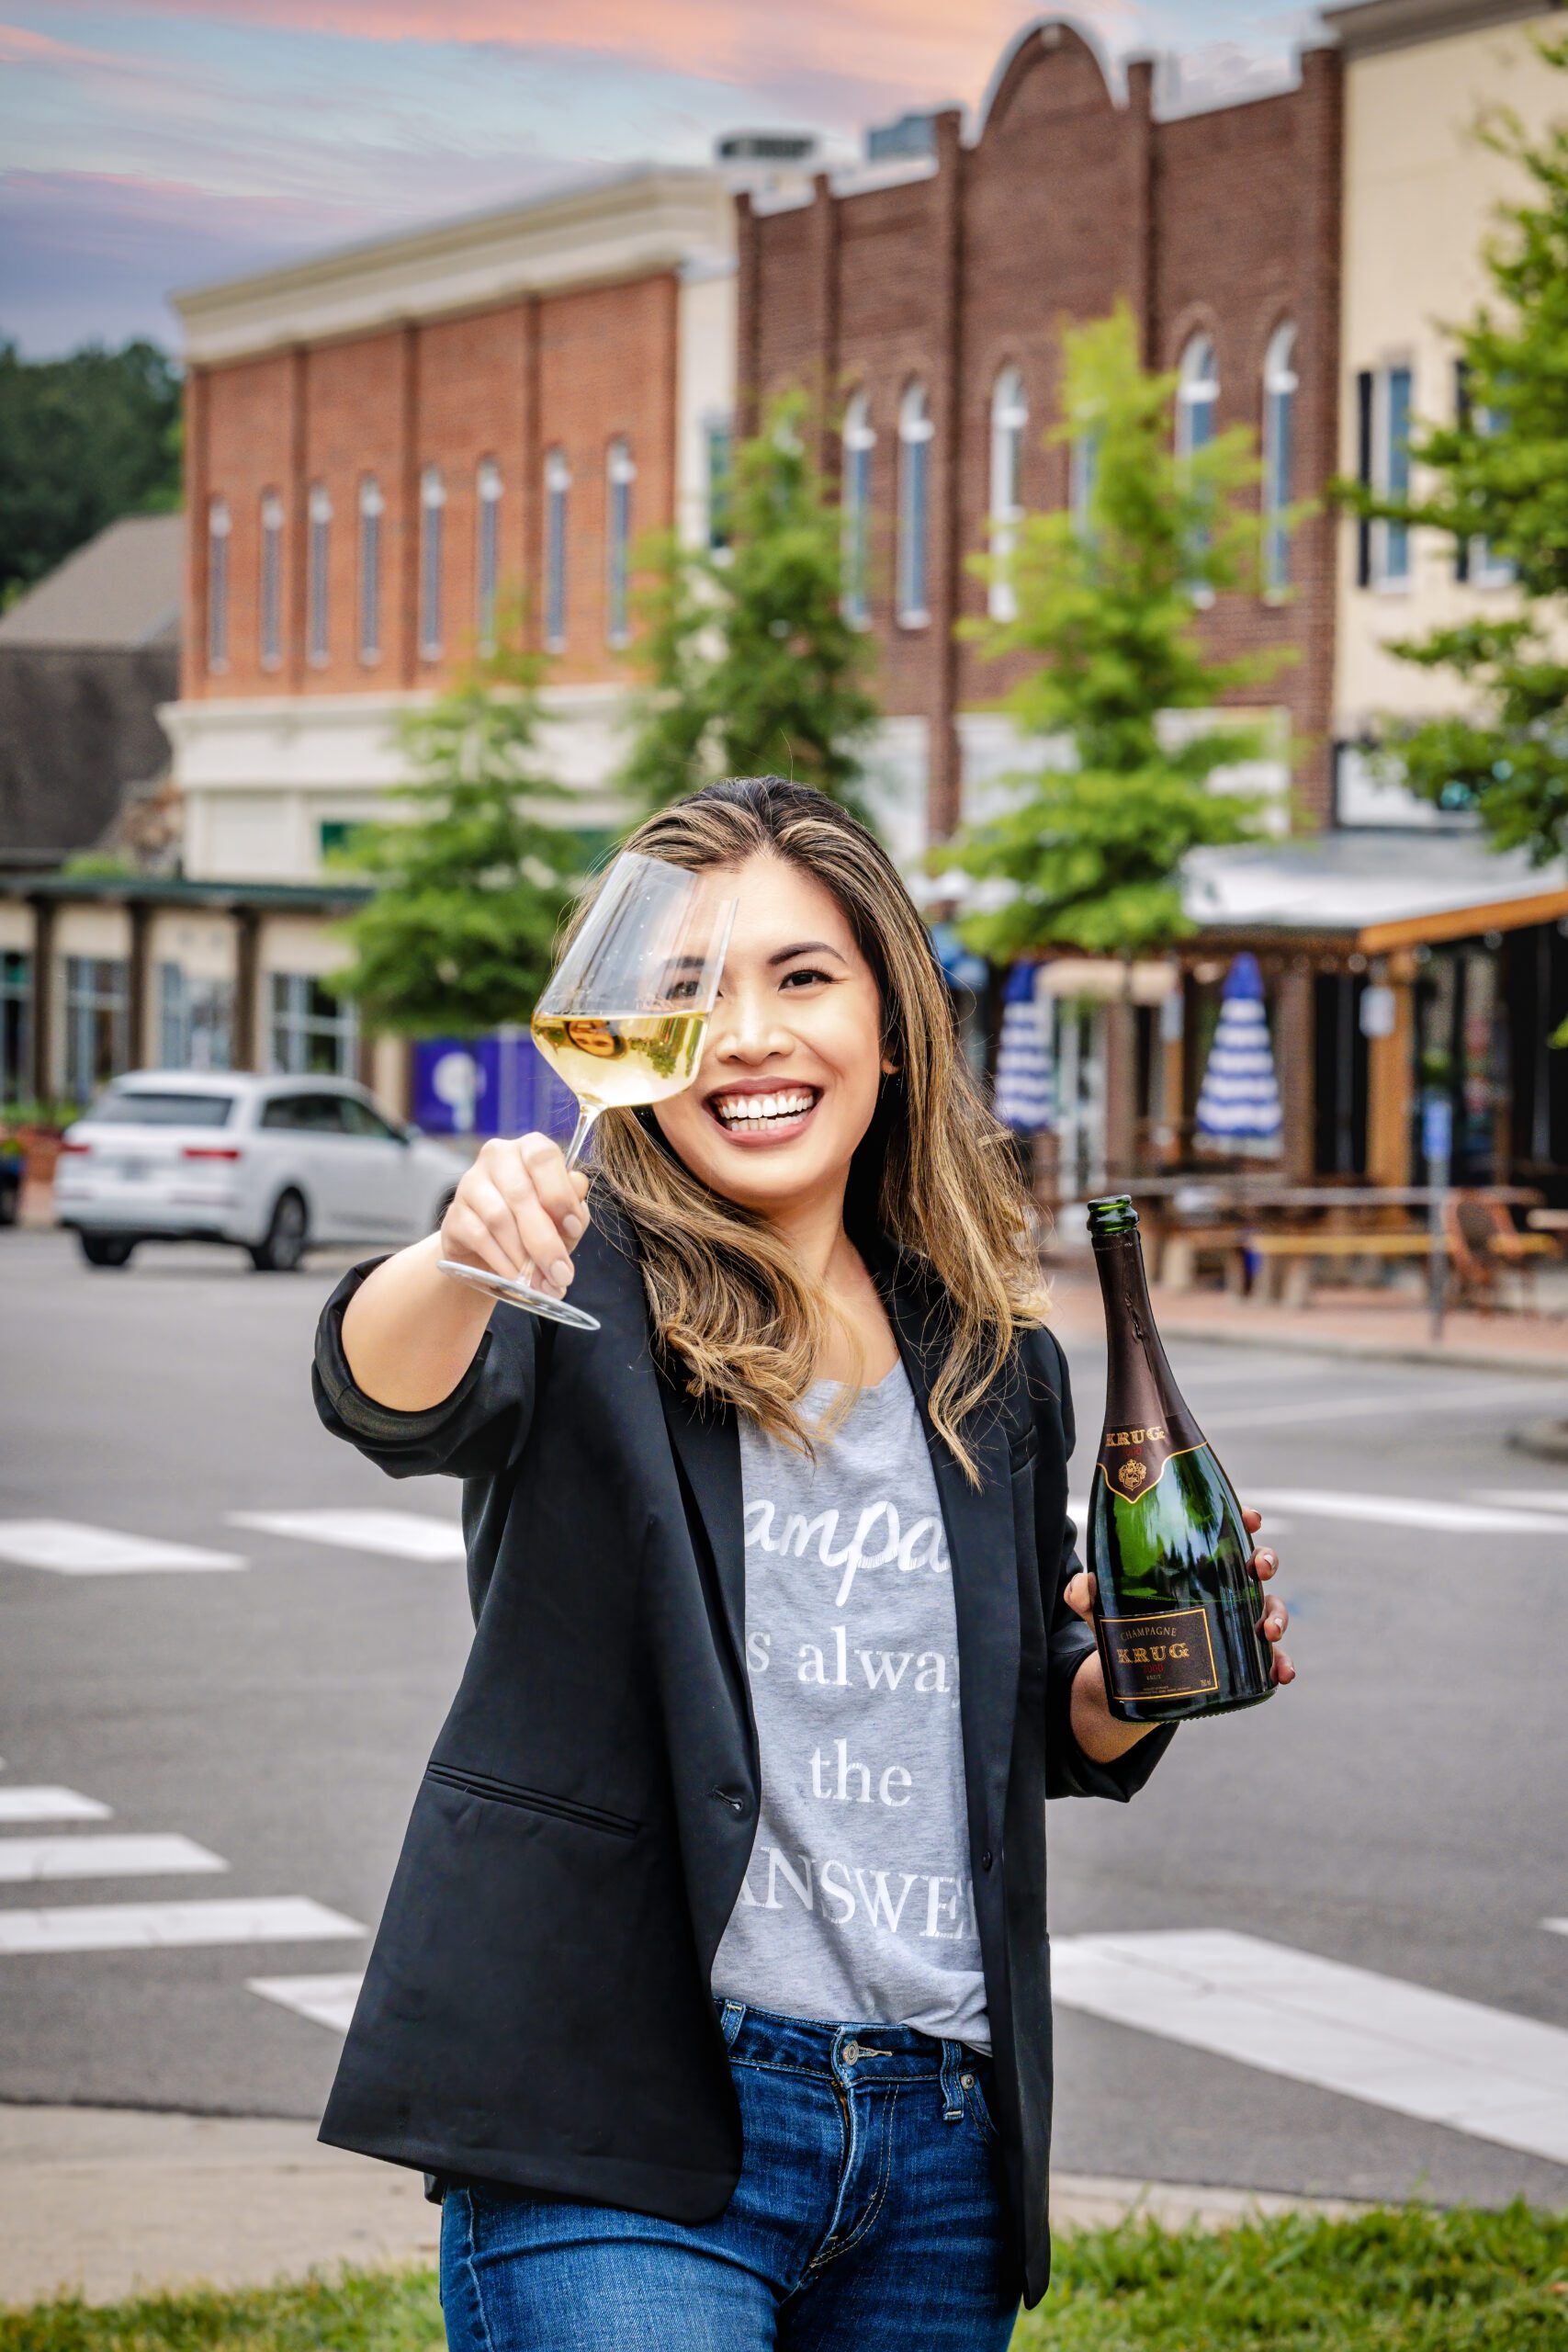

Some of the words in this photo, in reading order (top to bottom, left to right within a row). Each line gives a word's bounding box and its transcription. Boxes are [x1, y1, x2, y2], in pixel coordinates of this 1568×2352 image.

[1105, 1427, 1165, 1447] KRUG
[1120, 1626, 1178, 1641] CHAMPAGNE
[1116, 1642, 1190, 1664] KRUG
[797, 1625, 960, 1709] alwa
[808, 1737, 912, 1807] the
